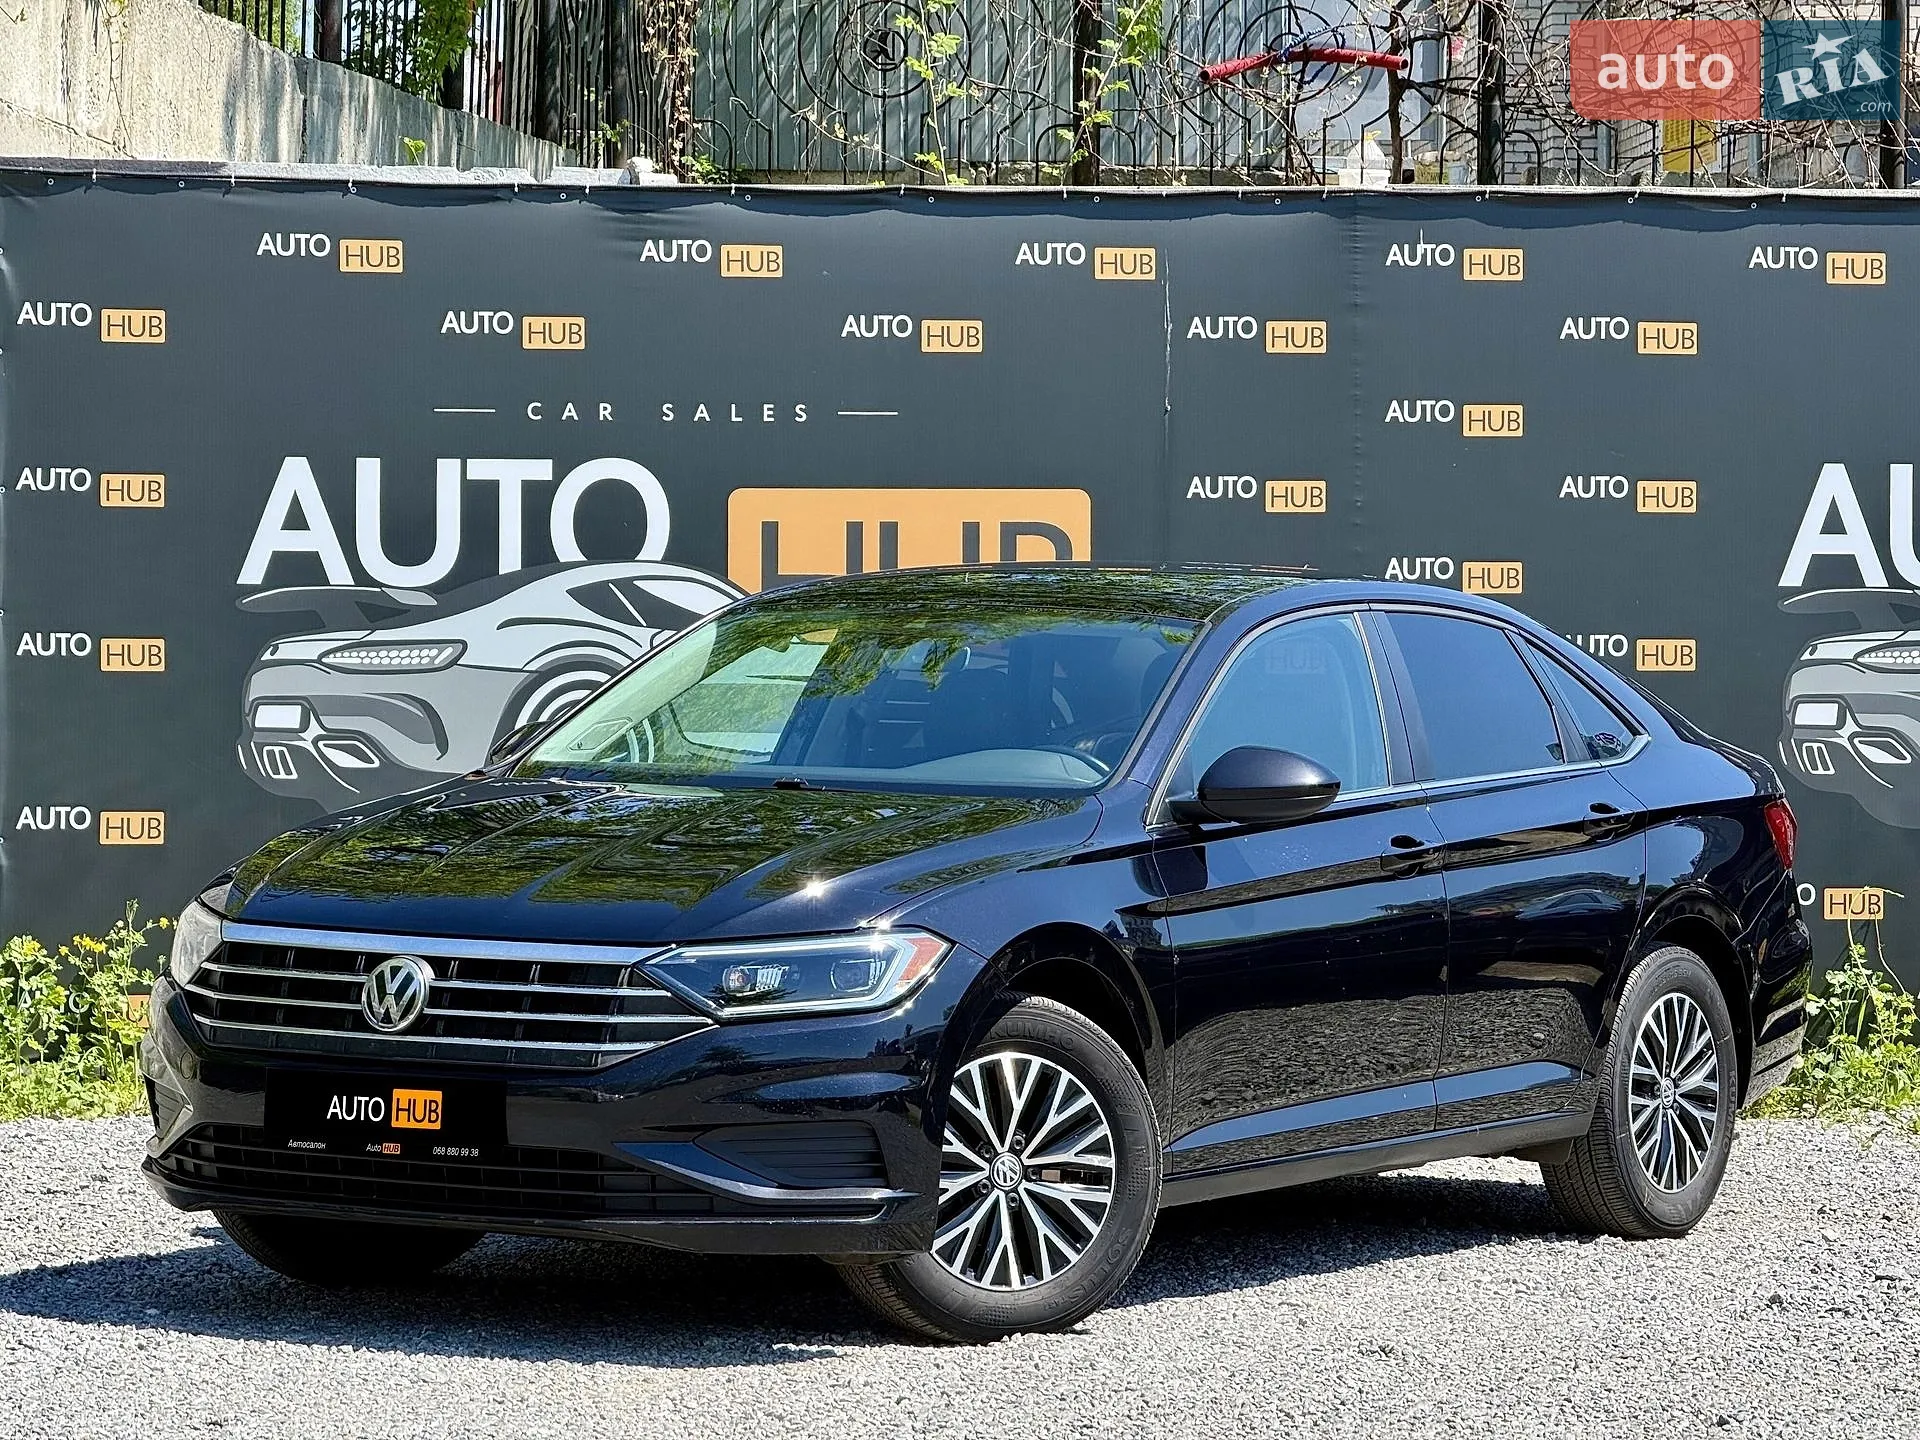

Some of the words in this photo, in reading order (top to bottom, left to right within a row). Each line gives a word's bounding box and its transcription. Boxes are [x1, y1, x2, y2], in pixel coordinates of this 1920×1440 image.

[257, 233, 330, 257] AUTO
[344, 243, 400, 269] HUB
[640, 240, 712, 262] AUTO
[725, 249, 779, 274] HUB
[1015, 243, 1085, 265] AUTO
[1099, 251, 1152, 276] HUB
[1386, 244, 1455, 266] AUTO
[1467, 252, 1520, 277] HUB
[1749, 247, 1818, 269] AUTO
[1830, 256, 1882, 281] HUB
[17, 302, 92, 326] AUTO
[105, 313, 163, 339] HUB
[441, 311, 513, 334] AUTO
[527, 320, 583, 346] HUB
[841, 315, 912, 337] AUTO
[925, 324, 978, 349] HUB
[1187, 316, 1257, 339] AUTO
[1270, 325, 1323, 350] HUB
[1560, 317, 1629, 339] AUTO
[1642, 326, 1695, 351] HUB
[527, 402, 613, 421] CAR
[662, 403, 808, 422] SALES
[1385, 400, 1454, 422] AUTO
[1467, 409, 1520, 433] HUB
[16, 468, 91, 491] AUTO
[104, 478, 163, 504] HUB
[1187, 476, 1257, 498] AUTO
[1269, 484, 1324, 509] HUB
[1560, 476, 1628, 498] AUTO
[1641, 485, 1694, 510] HUB
[236, 457, 671, 587] AUTO
[1385, 557, 1454, 578] AUTO
[1466, 566, 1520, 591] HUB
[17, 633, 91, 656] AUTO
[105, 642, 162, 668] HUB
[1640, 643, 1692, 668] HUB
[16, 807, 91, 829] AUTO
[104, 815, 162, 841] HUB
[1828, 892, 1882, 918] HUB
[326, 1095, 385, 1122] AUTO
[394, 1096, 441, 1126] HUB
[287, 1138, 327, 1150] Автосалон
[366, 1143, 382, 1152] Auto
[382, 1143, 400, 1153] HUB
[432, 1146, 446, 1156] 068
[446, 1147, 460, 1157] 880
[460, 1147, 470, 1157] 99
[469, 1148, 480, 1157] 38
